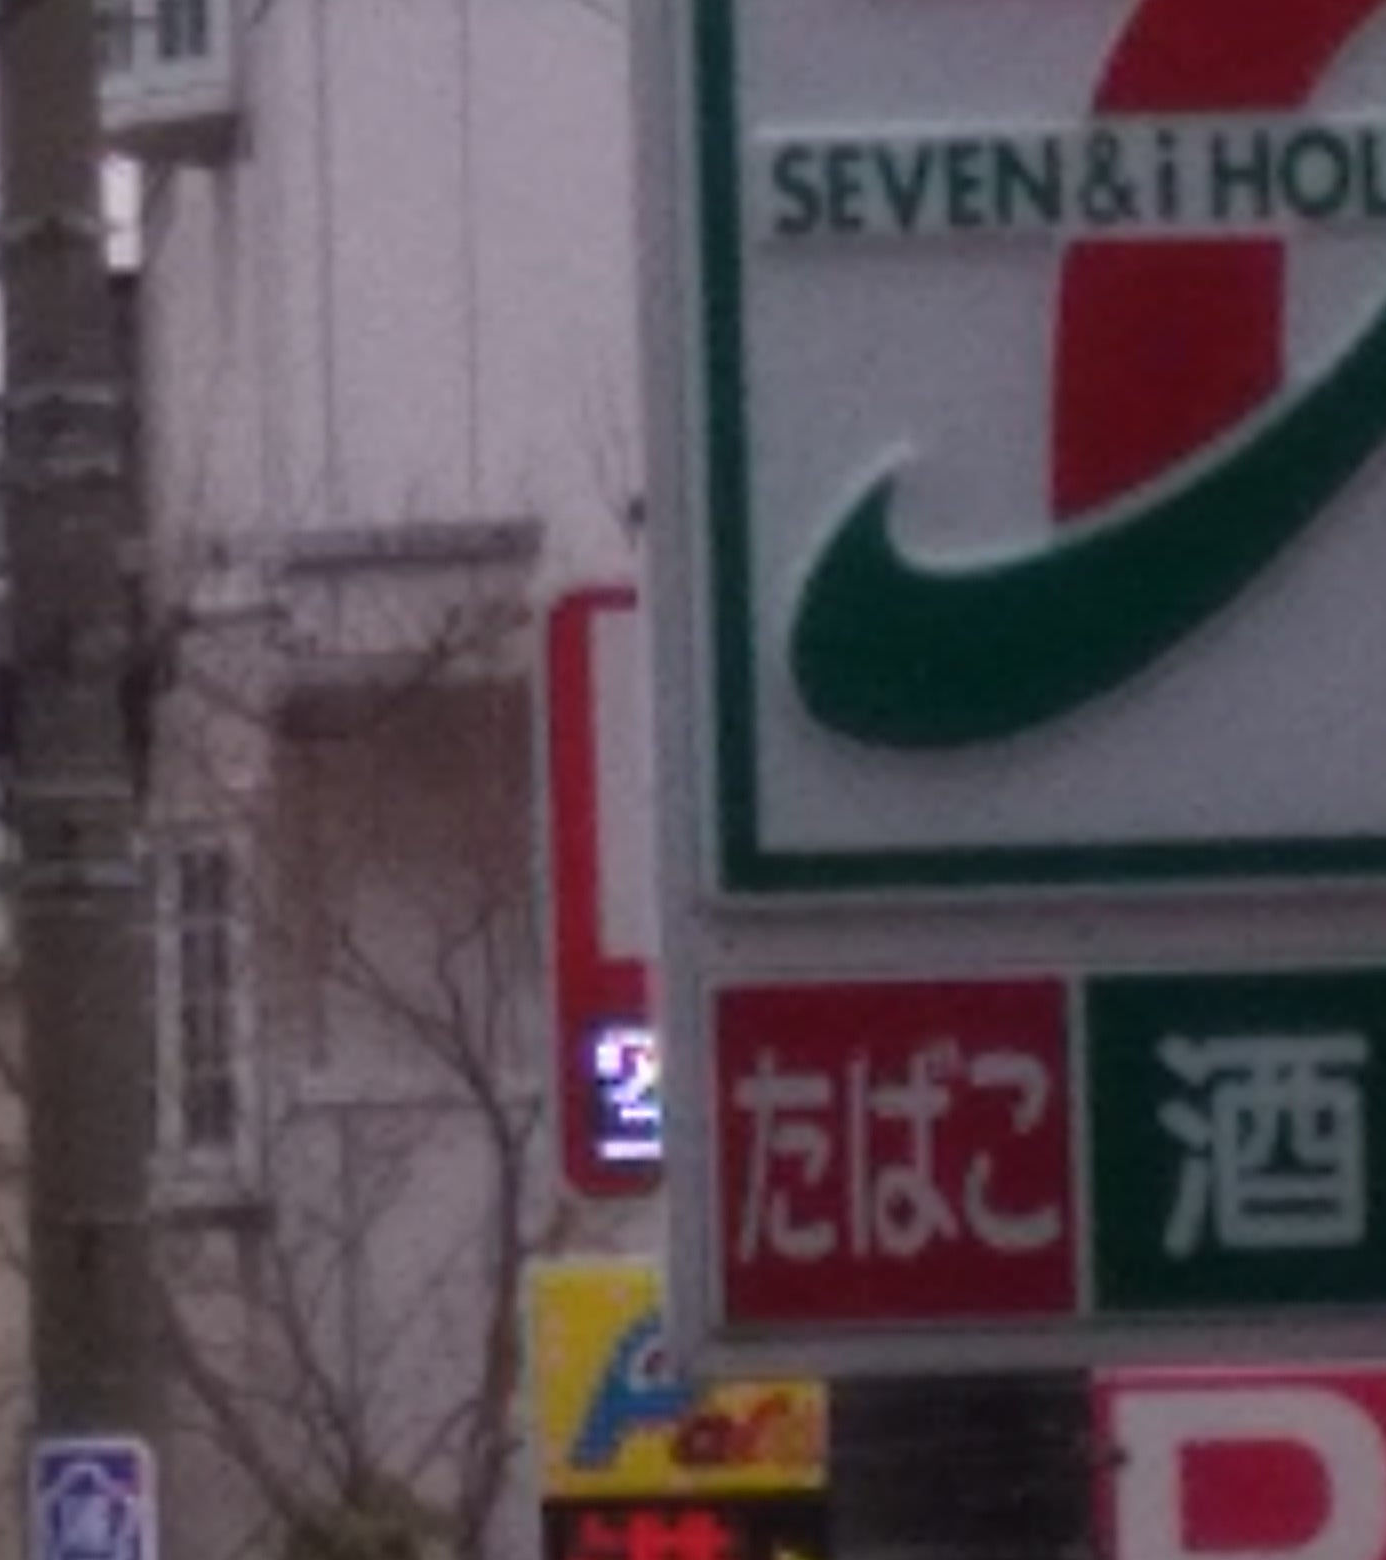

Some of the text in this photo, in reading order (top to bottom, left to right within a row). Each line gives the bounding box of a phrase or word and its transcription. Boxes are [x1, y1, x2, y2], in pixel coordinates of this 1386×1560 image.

[733, 1034, 1061, 1263] たばこ
[1156, 1032, 1368, 1257] 酒
